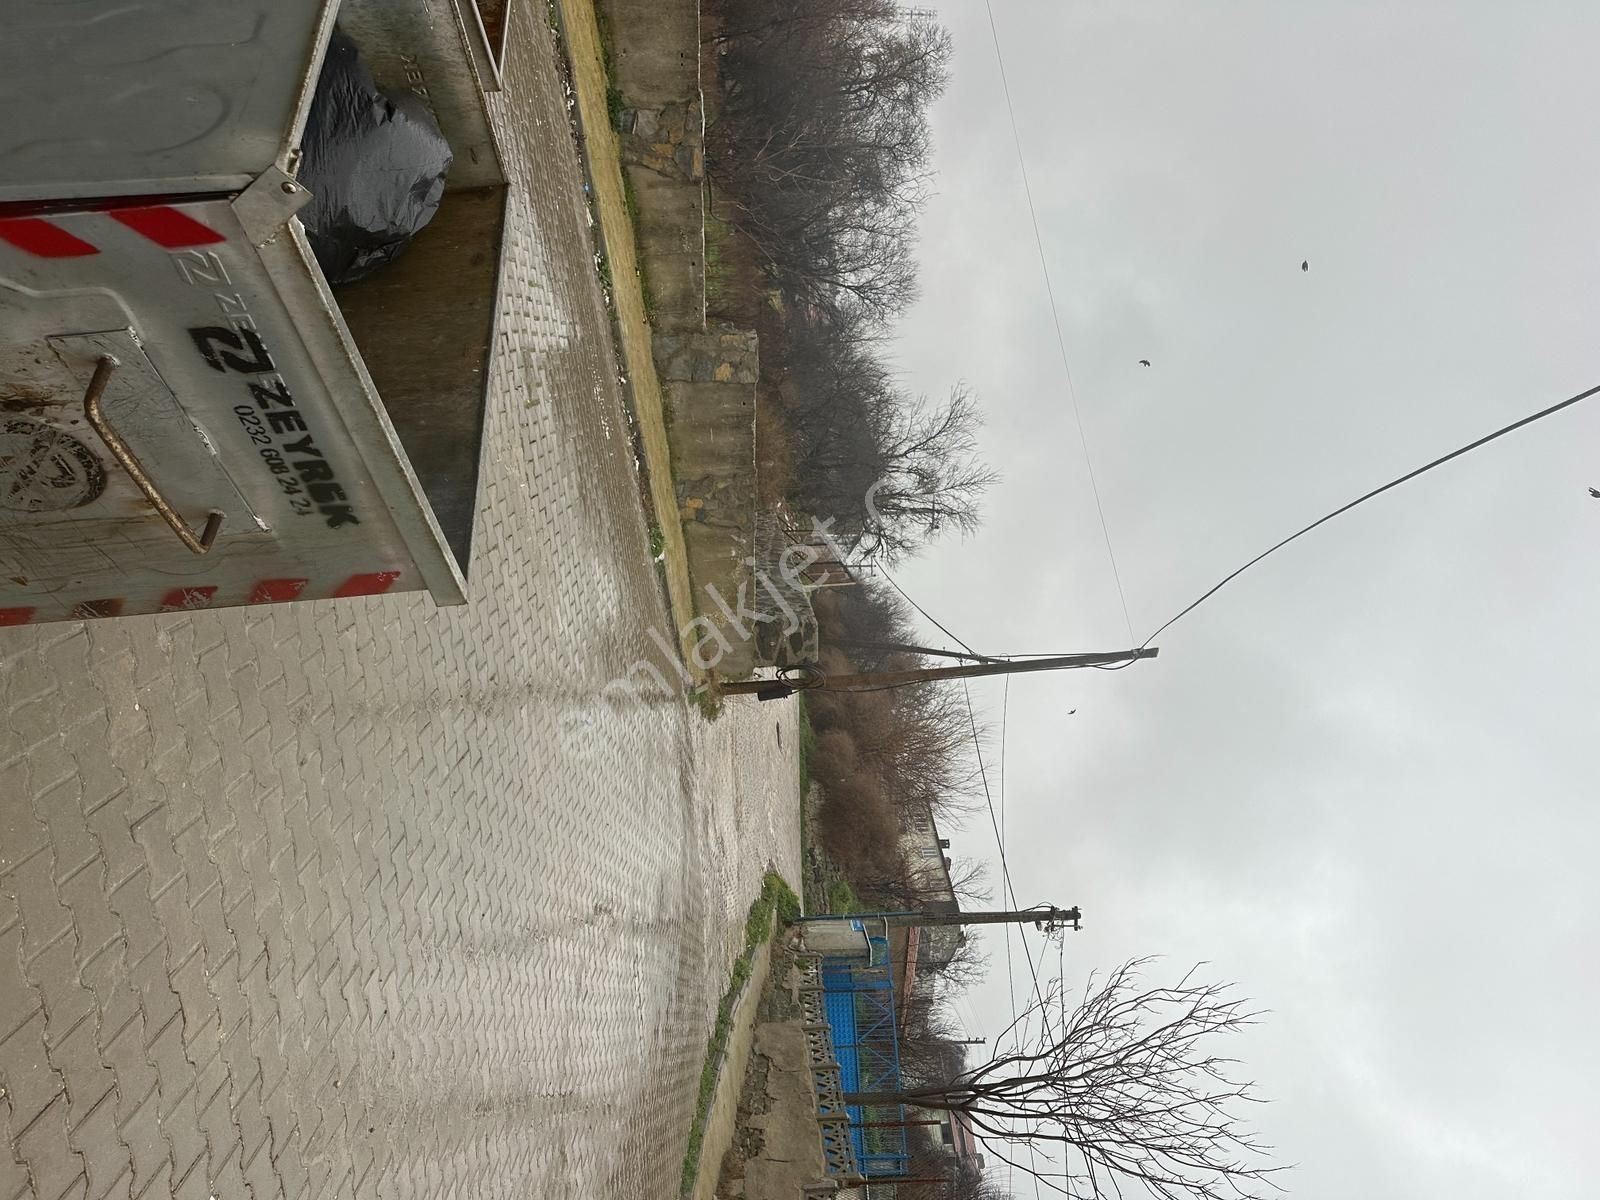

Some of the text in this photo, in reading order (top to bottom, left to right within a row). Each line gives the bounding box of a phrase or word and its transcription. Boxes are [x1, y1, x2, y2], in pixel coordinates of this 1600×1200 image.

[233, 405, 272, 446] 0232
[260, 448, 290, 475] 608
[276, 477, 303, 496] 24
[248, 379, 361, 529] ZEYREK
